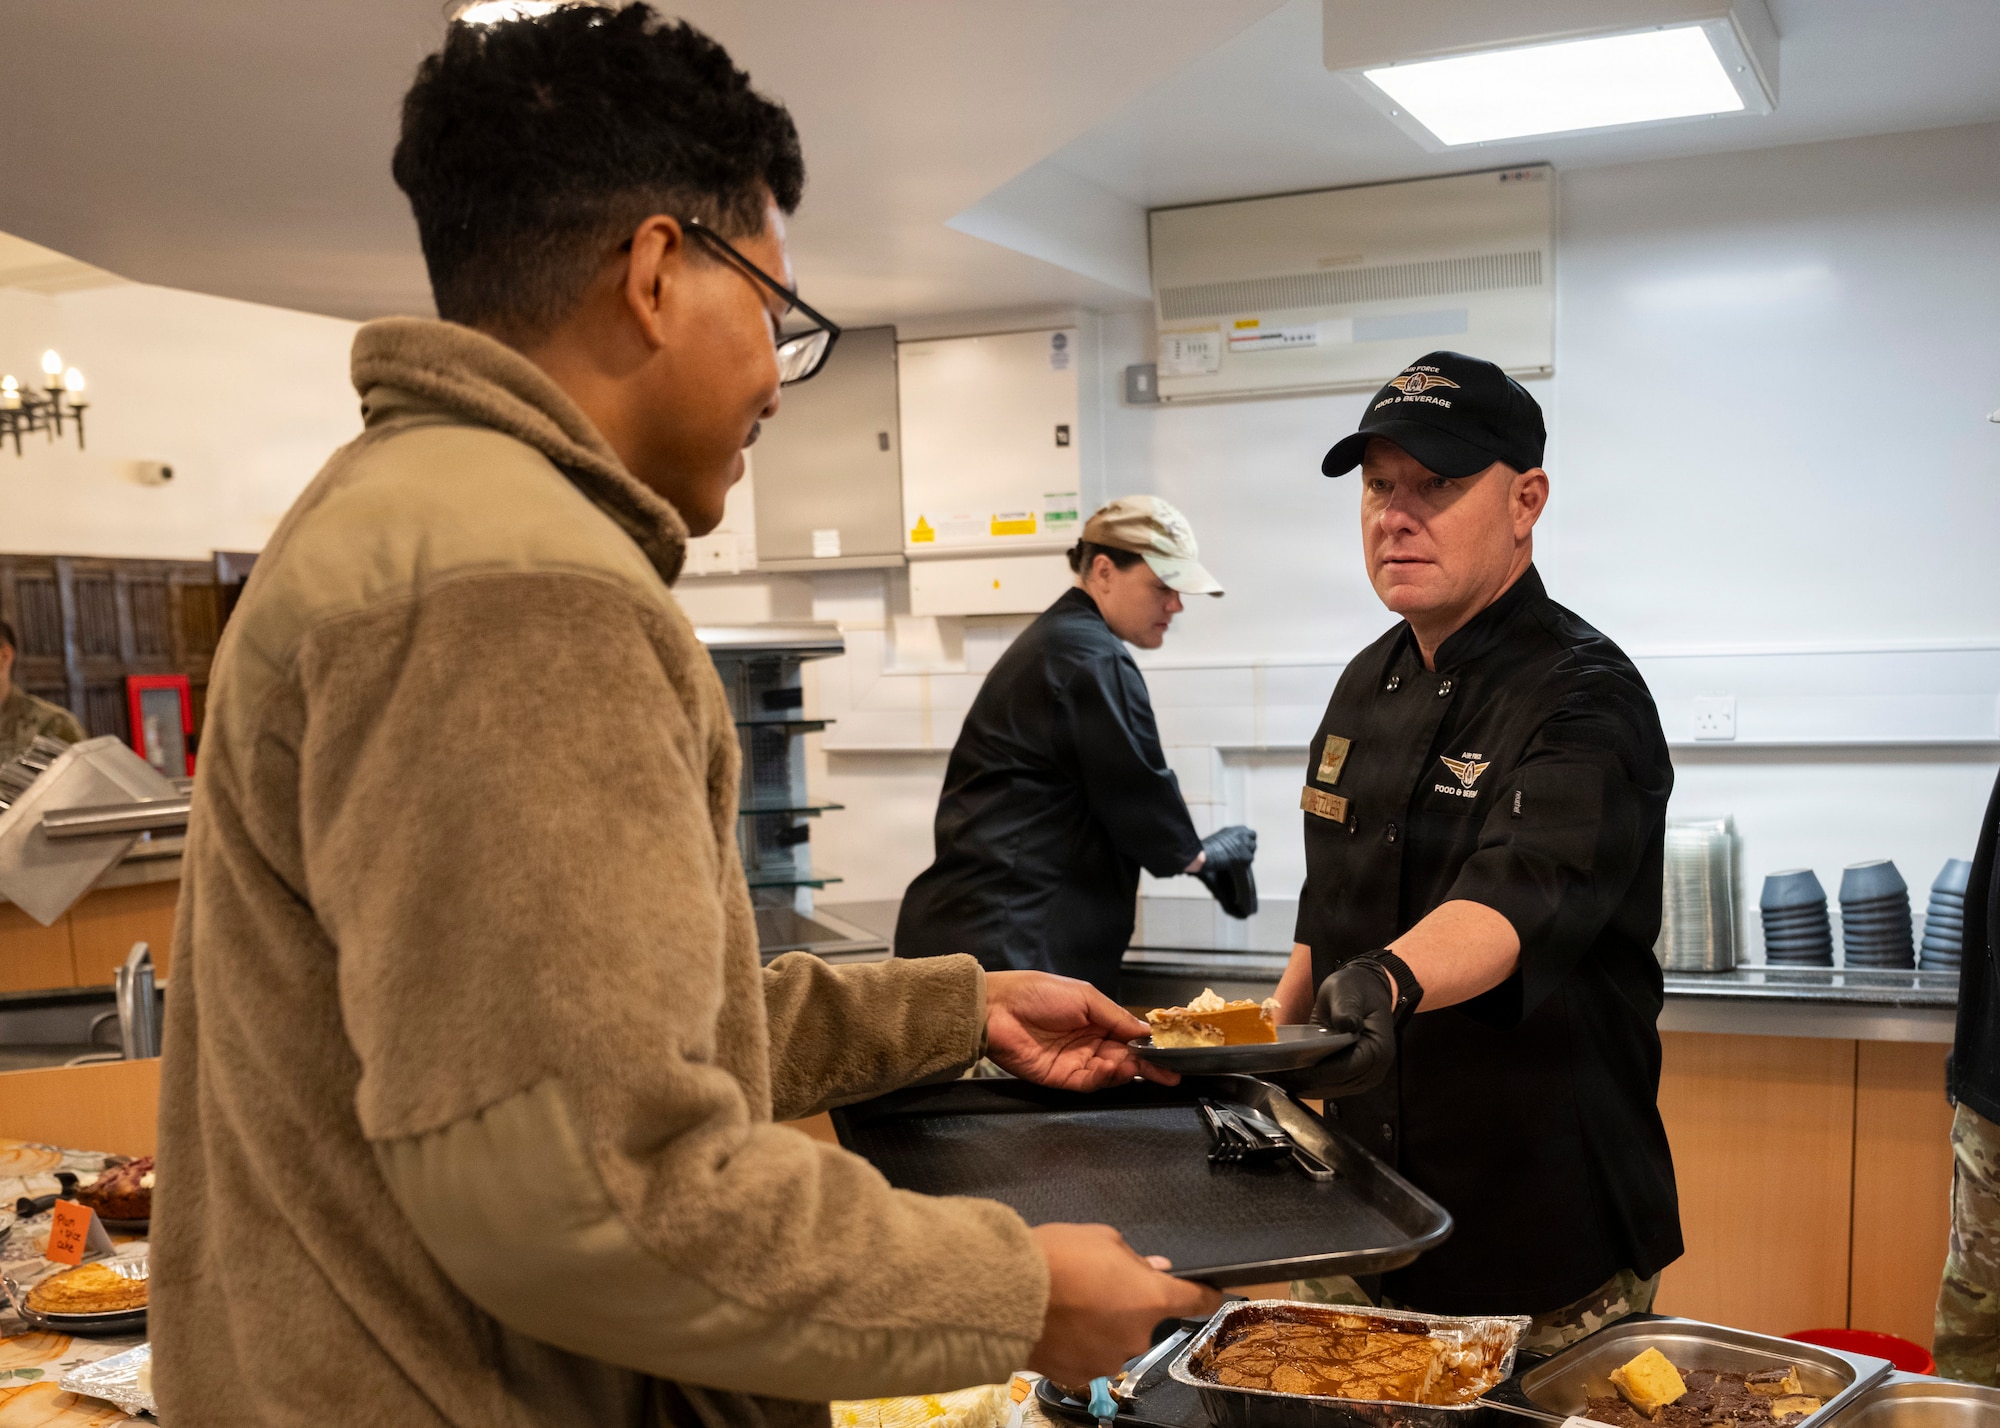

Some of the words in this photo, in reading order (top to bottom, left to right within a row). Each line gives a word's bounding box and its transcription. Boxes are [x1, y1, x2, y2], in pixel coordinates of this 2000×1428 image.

[1416, 365, 1441, 374] FORCE
[1374, 397, 1394, 412] FOOD
[1394, 396, 1402, 404] &
[1402, 395, 1452, 409] BEVERAGE
[1461, 751, 1472, 760] AIR
[1434, 783, 1455, 795] FOOD
[1455, 788, 1462, 796] &
